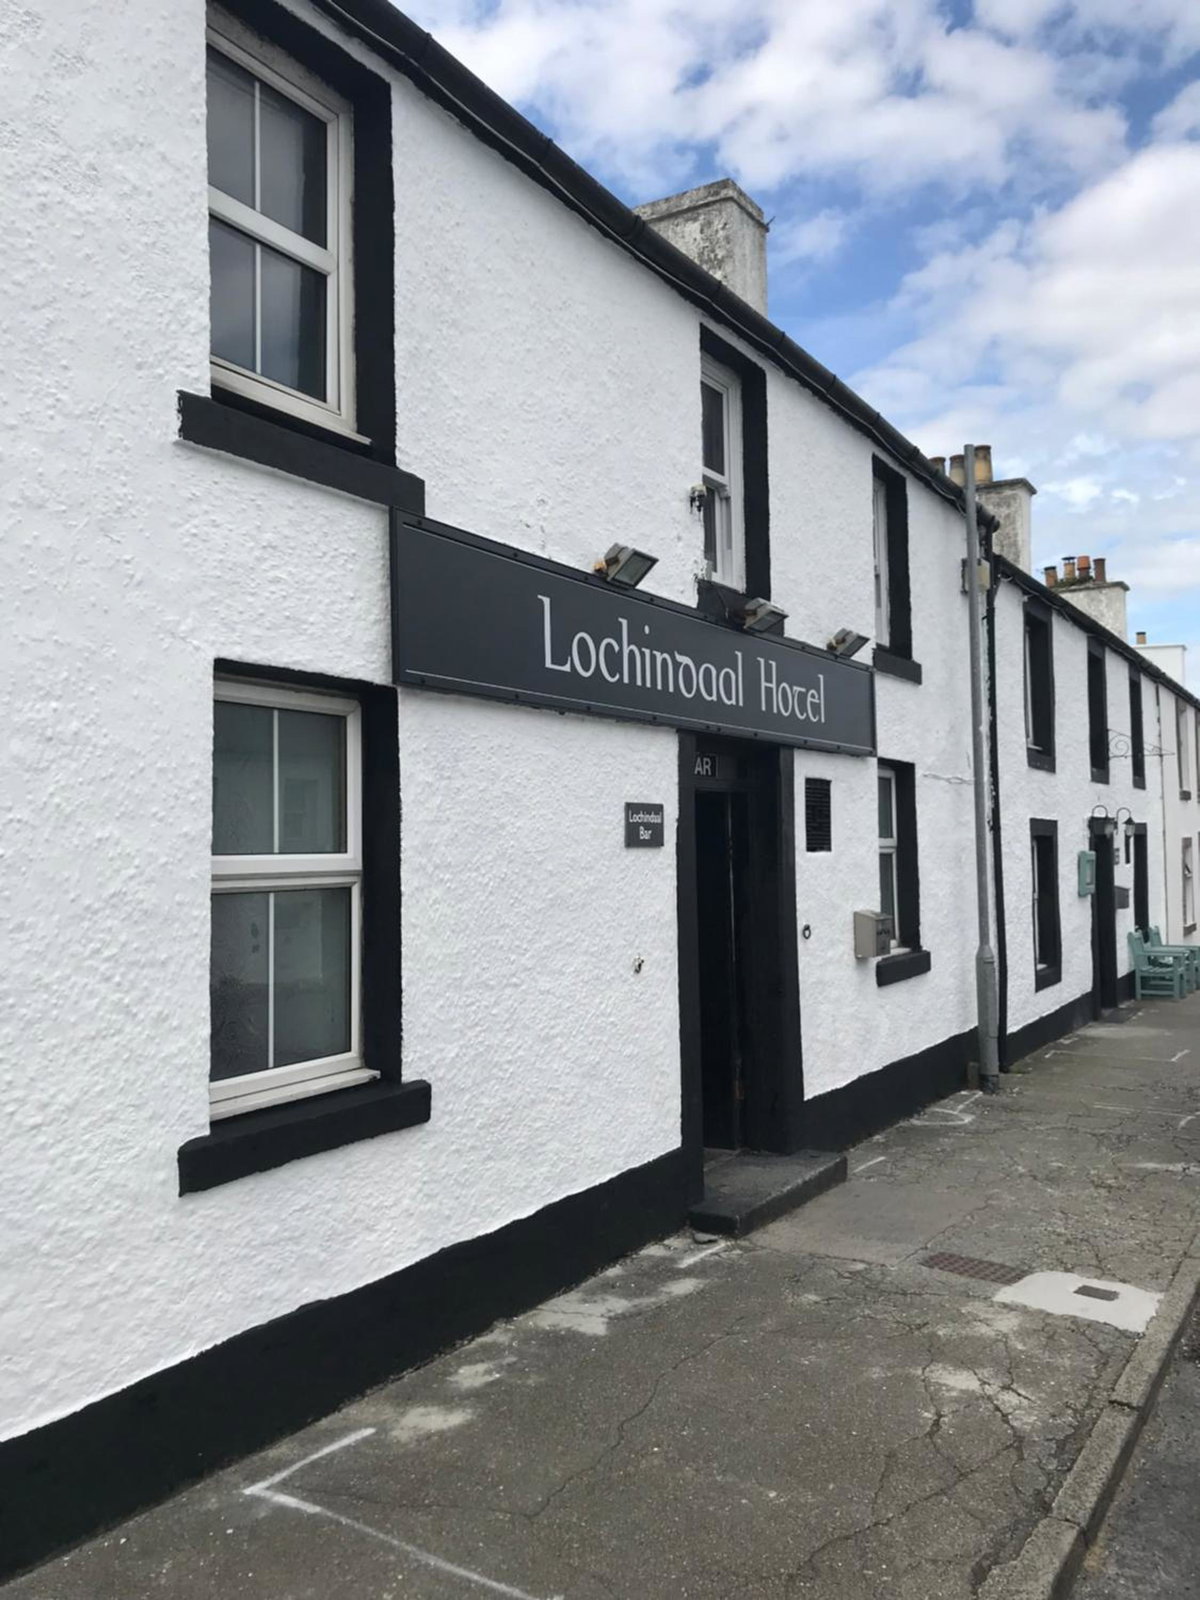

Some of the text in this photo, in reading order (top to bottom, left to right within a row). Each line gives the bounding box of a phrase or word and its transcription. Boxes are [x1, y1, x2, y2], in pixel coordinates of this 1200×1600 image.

[537, 594, 826, 724] Lochindaal Hotel
[639, 825, 652, 840] Bar
